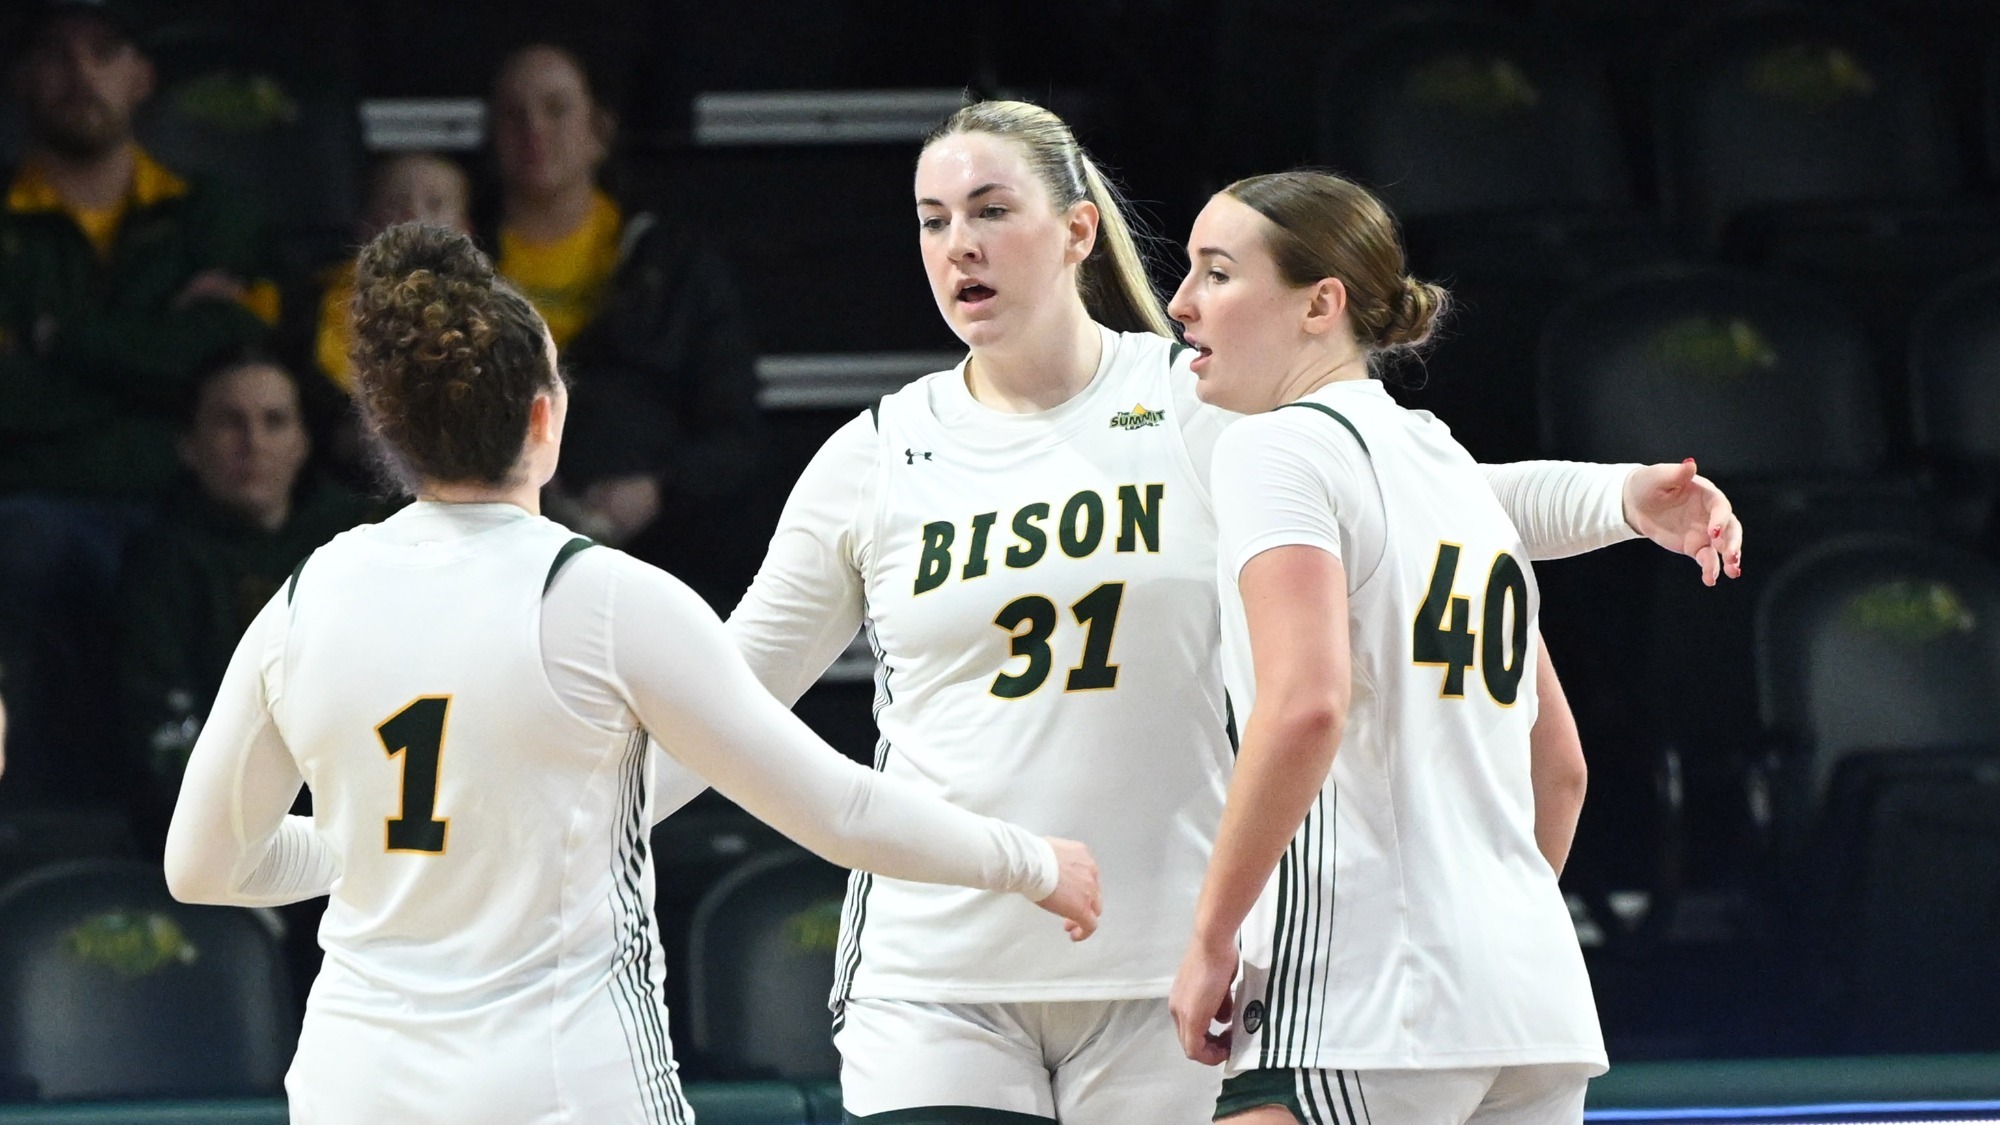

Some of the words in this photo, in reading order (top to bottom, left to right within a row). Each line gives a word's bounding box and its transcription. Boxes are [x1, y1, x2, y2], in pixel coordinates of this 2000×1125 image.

[1109, 409, 1165, 428] SUMMIT
[913, 483, 1164, 596] BISON
[989, 580, 1126, 700] 31
[1412, 540, 1527, 708] 40
[374, 694, 453, 856] 1
